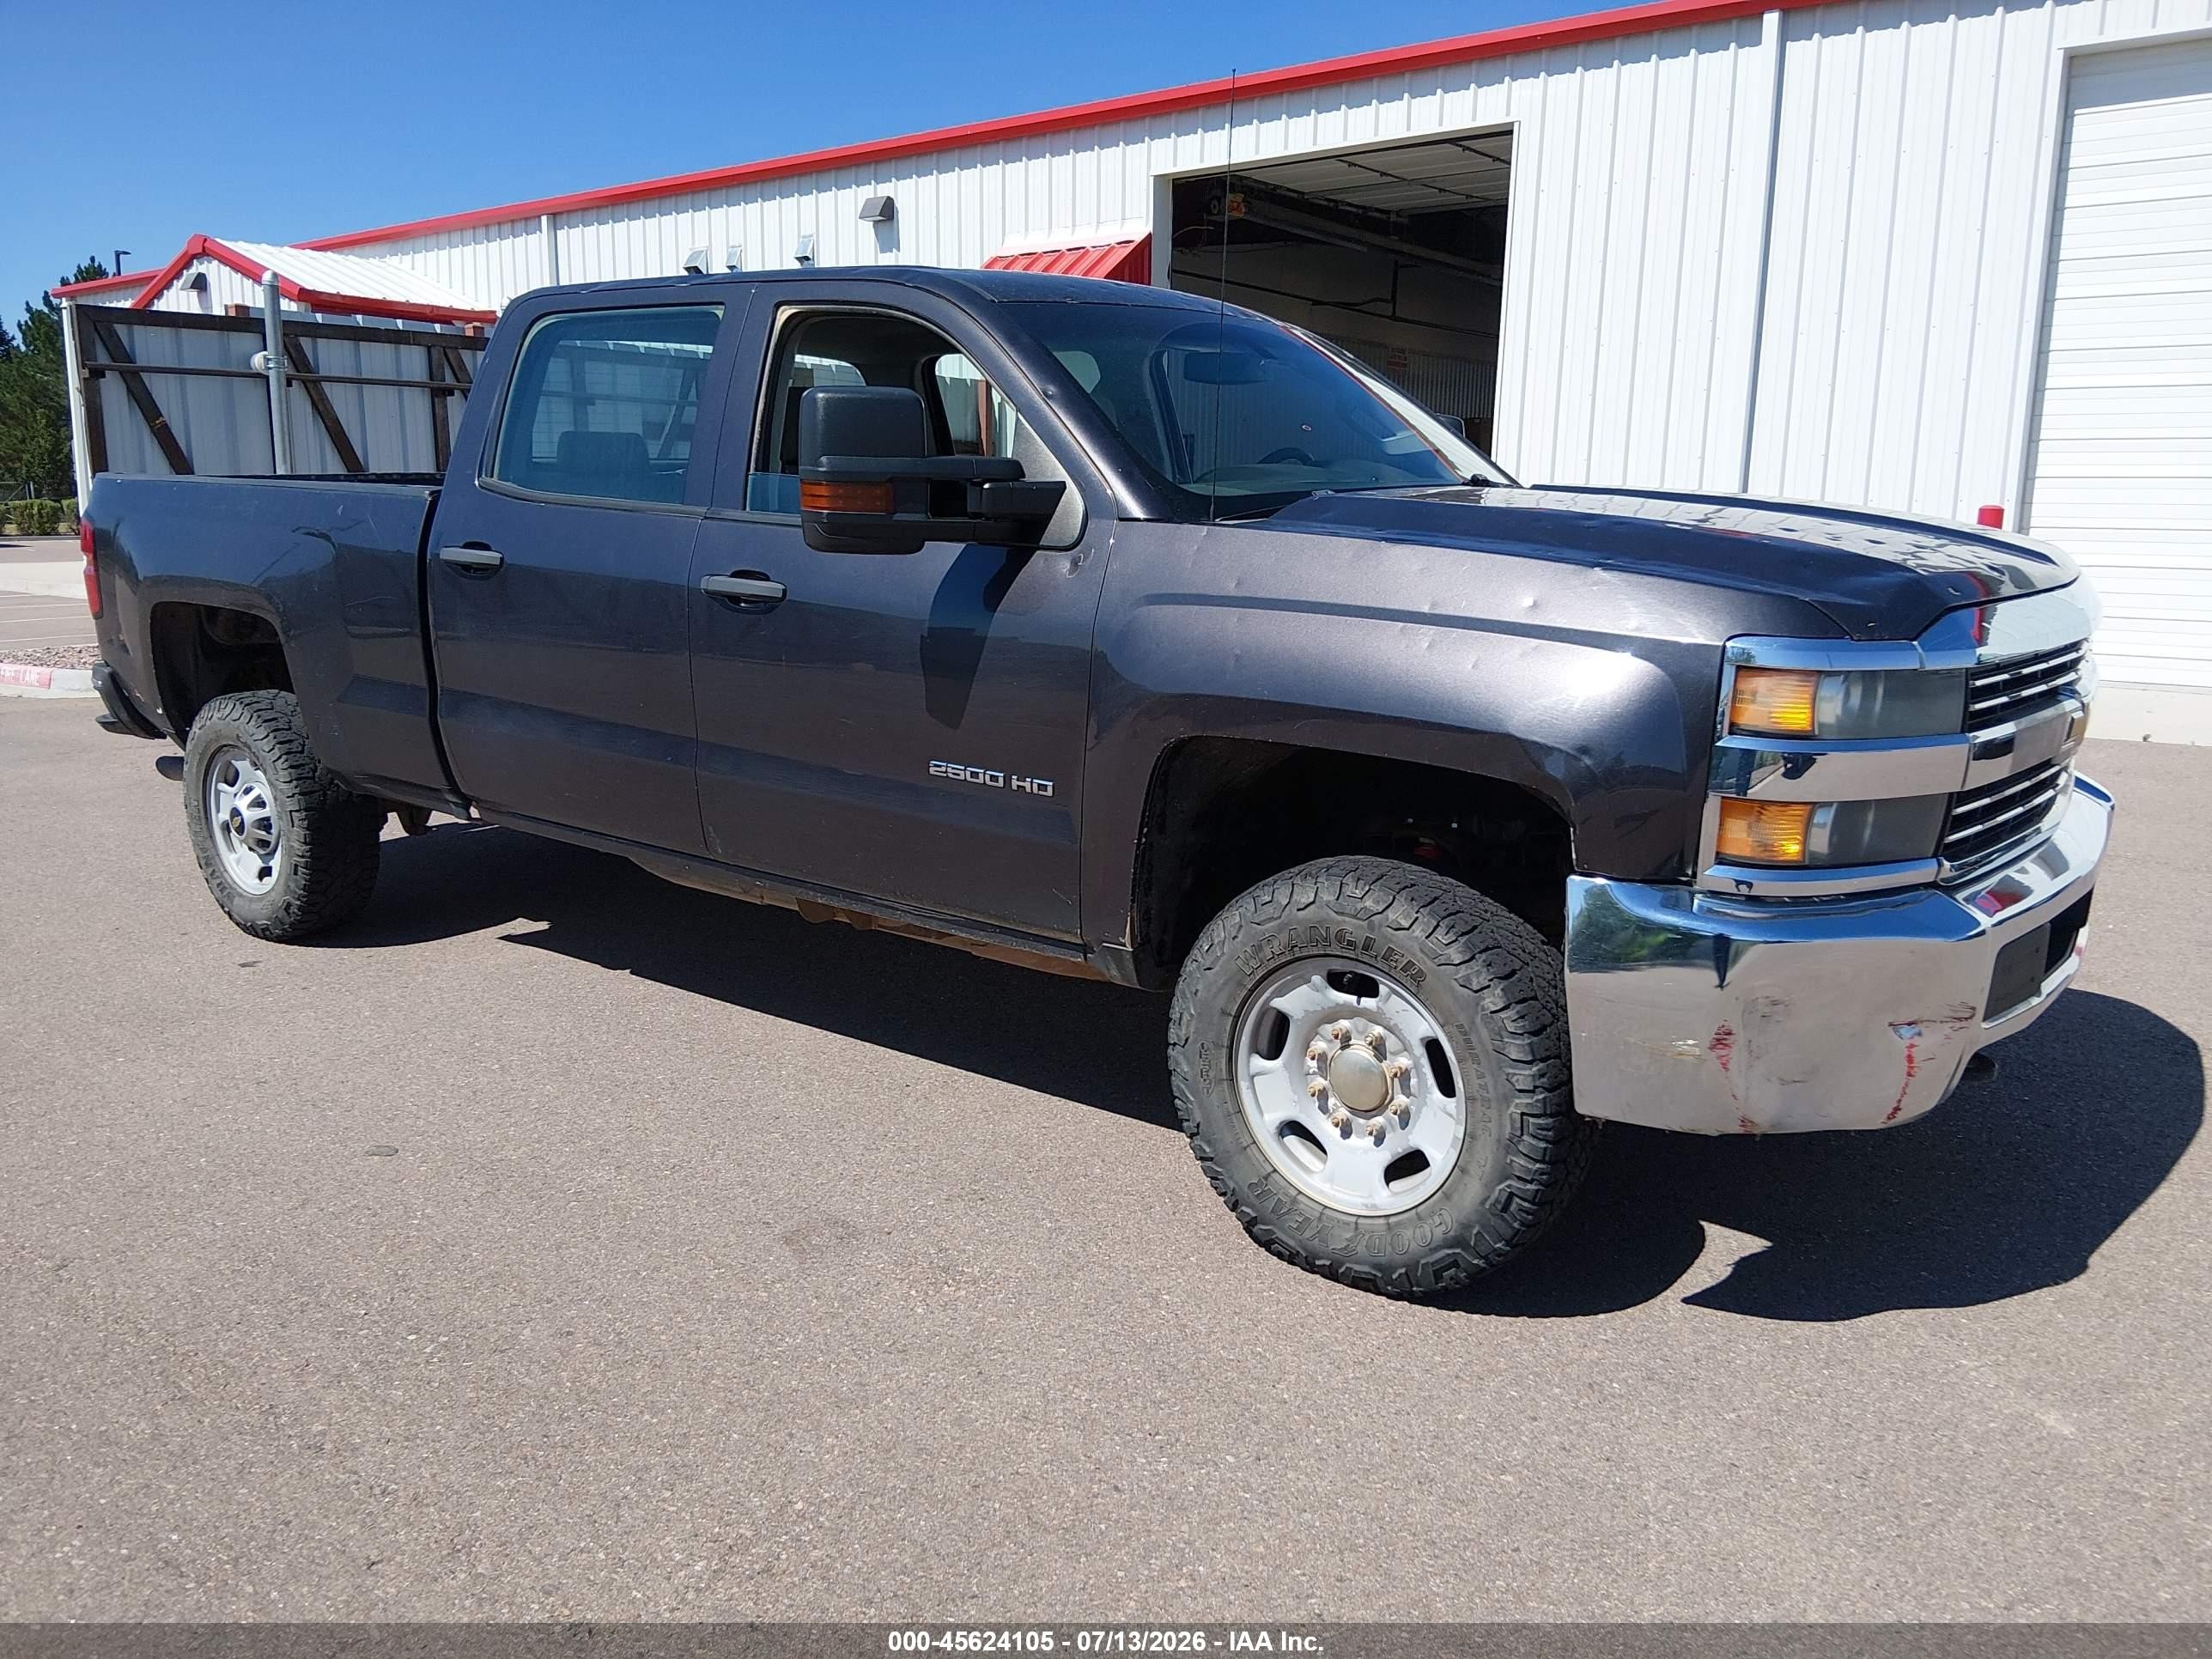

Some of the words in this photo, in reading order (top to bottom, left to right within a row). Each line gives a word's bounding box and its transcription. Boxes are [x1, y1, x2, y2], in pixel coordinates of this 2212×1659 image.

[20, 668, 40, 686] LANE
[929, 760, 1005, 788] 2500
[1012, 775, 1054, 797] HD
[1234, 924, 1427, 988] WRANGLER
